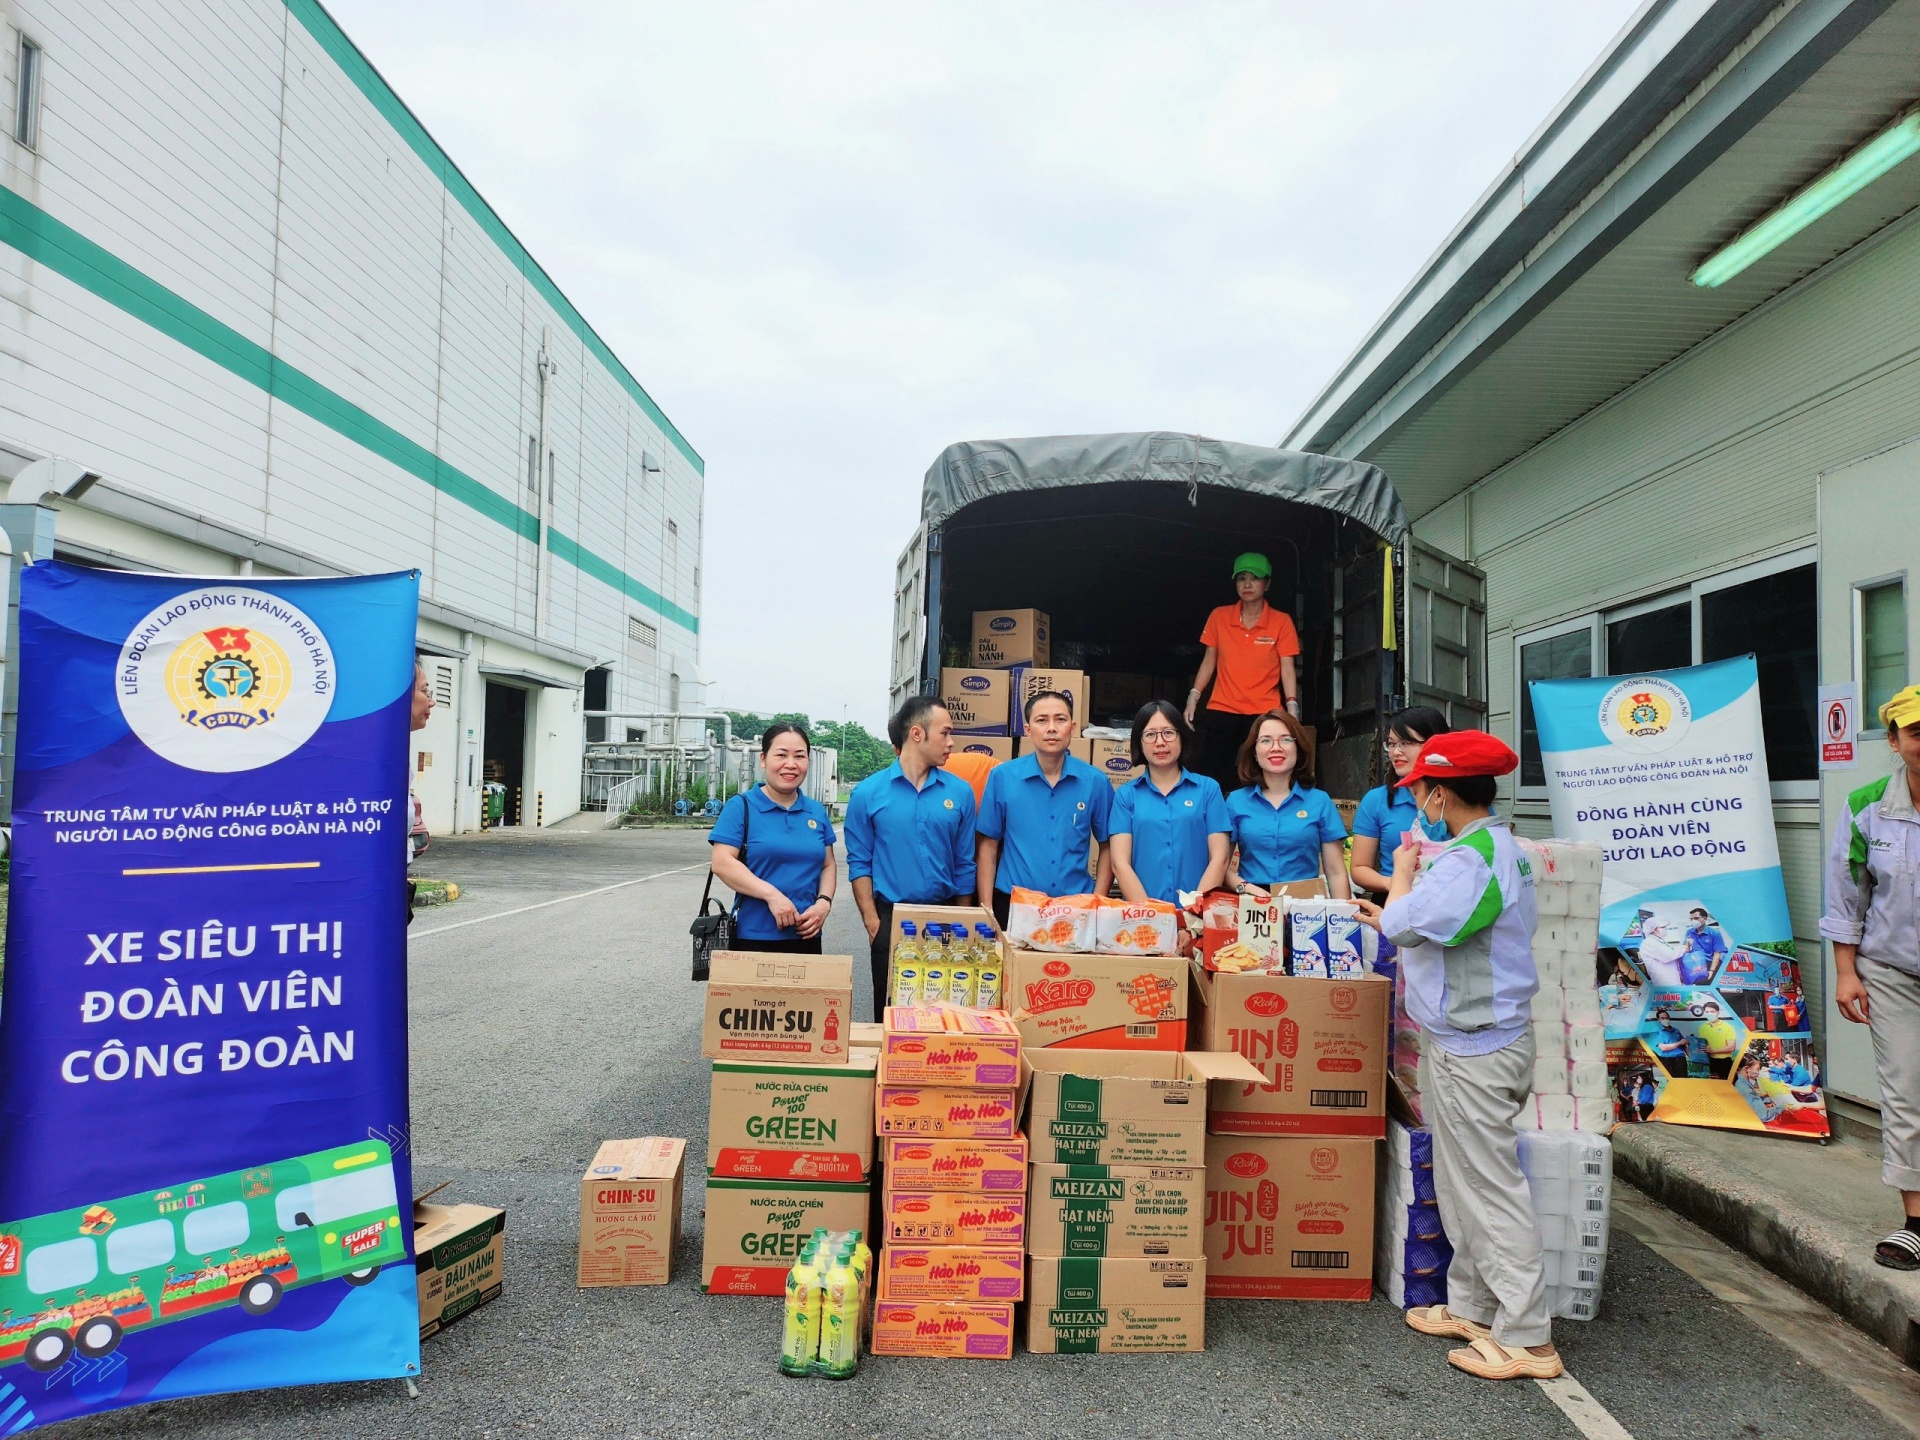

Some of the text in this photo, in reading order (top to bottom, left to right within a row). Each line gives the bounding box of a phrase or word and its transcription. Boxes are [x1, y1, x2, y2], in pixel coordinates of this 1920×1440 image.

[992, 619, 1015, 629] Simply
[121, 593, 331, 695] LIÊN ĐOÀN LAO ĐỘNG THÀNH PHỐ HÀ NỘI
[963, 677, 989, 688] Simply
[1623, 679, 1643, 689] ĐỘNG
[1644, 679, 1668, 690] THÀNH
[205, 713, 251, 728] CĐVN
[1108, 759, 1131, 769] Simply
[1555, 752, 1754, 779] TRUNG TÂM TƯ VẤN PHÁP LUẬT & HỖ TRỢ
[1563, 765, 1749, 789] NGƯỜI LAO ĐỘNG CÔNG ĐOÀN HÀ NỘI
[44, 797, 392, 823] TRUNG TÂM TƯ VẤN PHÁP LUẬT & HỖ TRỢ
[1576, 797, 1743, 822] ĐỒNG HÀNH CÙNG
[55, 817, 381, 843] NGƯỜI LAO ĐỘNG CÔNG ĐOÀN HÀ NỘI
[1612, 820, 1711, 840] ĐOÀN VIÊN
[1602, 840, 1746, 862] GƯỜI LAO ĐỘNG
[1038, 905, 1072, 919] Karo
[1121, 907, 1157, 921] Karo
[1245, 909, 1267, 925] JIN
[1293, 912, 1324, 925] Cowhead
[1253, 924, 1271, 940] JU
[84, 919, 342, 965] XE SIÊU THỊ
[80, 970, 342, 1023] ĐOÀN VIÊN
[1025, 979, 1095, 1008] Karo
[753, 999, 786, 1008] Tương ớt
[1252, 996, 1280, 1013] Richy
[718, 1007, 813, 1033] CHIN-SU
[760, 1032, 778, 1040] ngon
[780, 1033, 797, 1041] bùng
[1060, 1024, 1087, 1034] Vị Ngon
[1227, 1028, 1274, 1059] JIN
[1281, 1022, 1295, 1053] 진주
[62, 1025, 354, 1084] CÔNG ĐOÀN
[926, 1047, 978, 1066] Hảo Hảo
[1323, 1046, 1356, 1056] Hàn Quốc
[1284, 1064, 1294, 1092] GOLD
[755, 1082, 781, 1091] NƯỚC
[783, 1081, 802, 1092] RỬA
[803, 1083, 828, 1093] CHÉN
[771, 1093, 810, 1108] Power
[786, 1103, 805, 1114] 100
[948, 1101, 1005, 1122] Hảo Hảo
[745, 1116, 837, 1142] GREEN
[1051, 1123, 1106, 1137] MEIZAN
[1055, 1138, 1100, 1151] HẠT NÊM
[733, 1164, 761, 1173] GREEN
[818, 1161, 850, 1172] BƯỞI TÂY
[932, 1155, 958, 1172] Hảo
[959, 1153, 984, 1170] Hảo
[1232, 1156, 1259, 1174] Richy
[597, 1188, 656, 1204] CHIN-SU
[1053, 1182, 1122, 1197] MEIZAN
[1155, 1189, 1182, 1198] LỰA CHỌN
[750, 1196, 824, 1208] NƯỚC RỬA CHÉN
[1135, 1197, 1151, 1205] DÀNH
[1164, 1197, 1176, 1206] ĐẦU
[1177, 1198, 1188, 1206] BẾP
[1261, 1184, 1275, 1213] 진주
[1134, 1206, 1188, 1216] CHUYÊN NGHIỆP
[1206, 1191, 1253, 1226] JIN
[1295, 1201, 1350, 1213] Bánh gạo nướng
[1303, 1208, 1339, 1218] Hàn Quốc
[766, 1209, 805, 1224] Power
[958, 1205, 1016, 1228] Hảo Hảo
[1060, 1208, 1114, 1223] HẠT NÊM
[782, 1219, 800, 1231] 100
[1076, 1225, 1083, 1233] VỊ
[344, 1221, 384, 1246] SUPER
[1264, 1226, 1274, 1255] GOLD
[353, 1238, 378, 1255] SALE
[1222, 1224, 1262, 1260] JU
[445, 1249, 494, 1289] ĐẬU NÀNH
[929, 1263, 955, 1280] Hảo
[956, 1260, 981, 1277] Hảo
[728, 1282, 757, 1291] GREEN
[915, 1316, 969, 1336] Hảo Hảo
[1051, 1313, 1106, 1324] MEIZAN
[1055, 1327, 1100, 1340] HẠT NÊM
